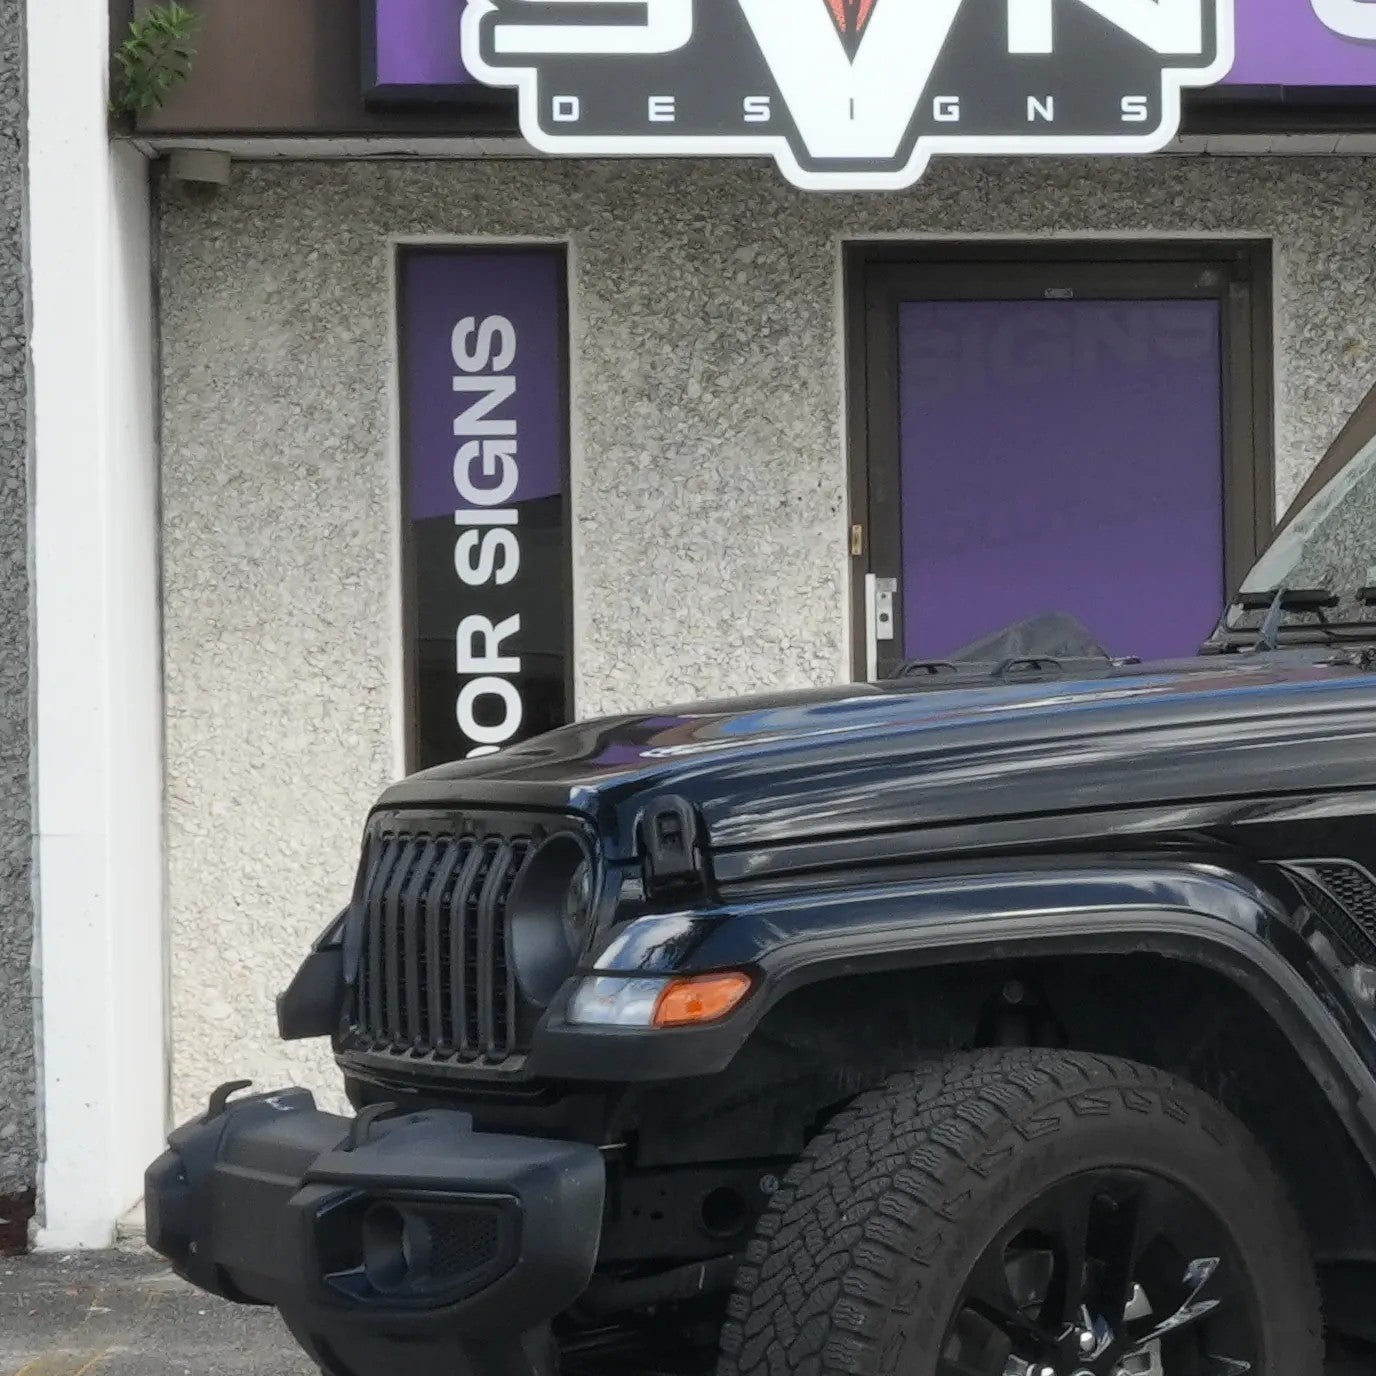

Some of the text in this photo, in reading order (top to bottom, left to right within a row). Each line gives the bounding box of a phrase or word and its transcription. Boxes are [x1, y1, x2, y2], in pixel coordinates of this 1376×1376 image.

[552, 96, 1147, 123] DESIGNS
[451, 315, 522, 758] OR SIGNS
